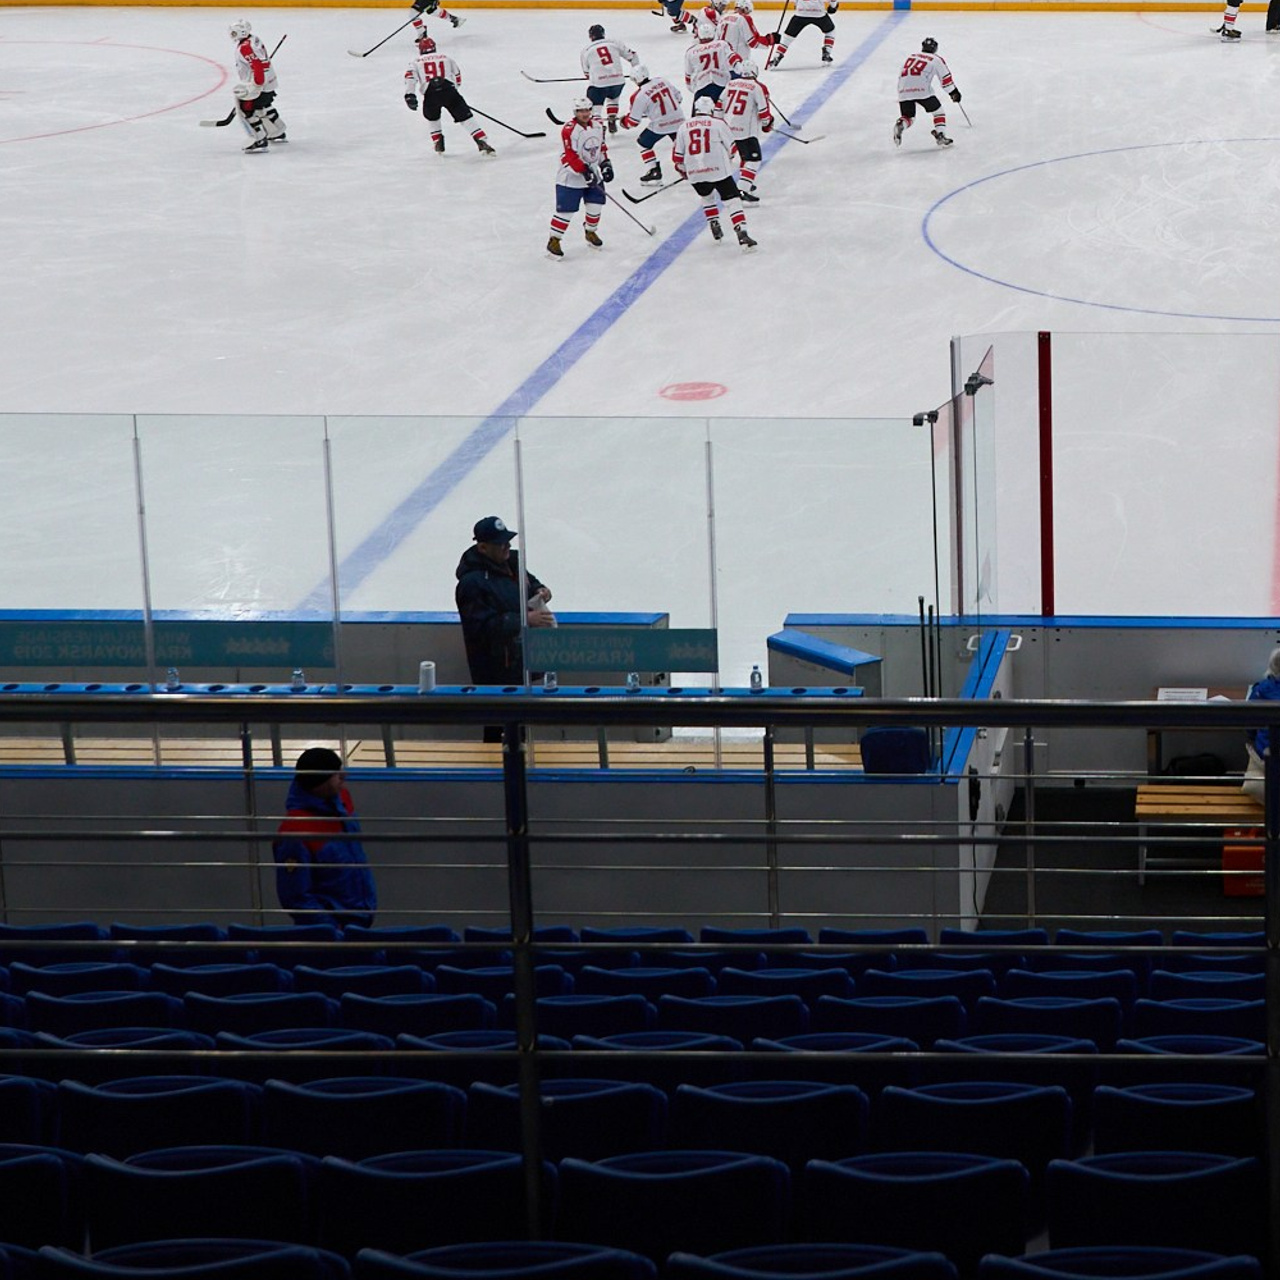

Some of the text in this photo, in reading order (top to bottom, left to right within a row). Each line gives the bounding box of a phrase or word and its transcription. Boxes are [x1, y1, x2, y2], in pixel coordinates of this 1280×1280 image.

[596, 45, 614, 66] 9
[699, 51, 719, 71] 71
[424, 61, 445, 82] 91
[650, 87, 677, 116] 77
[725, 89, 749, 115] 75
